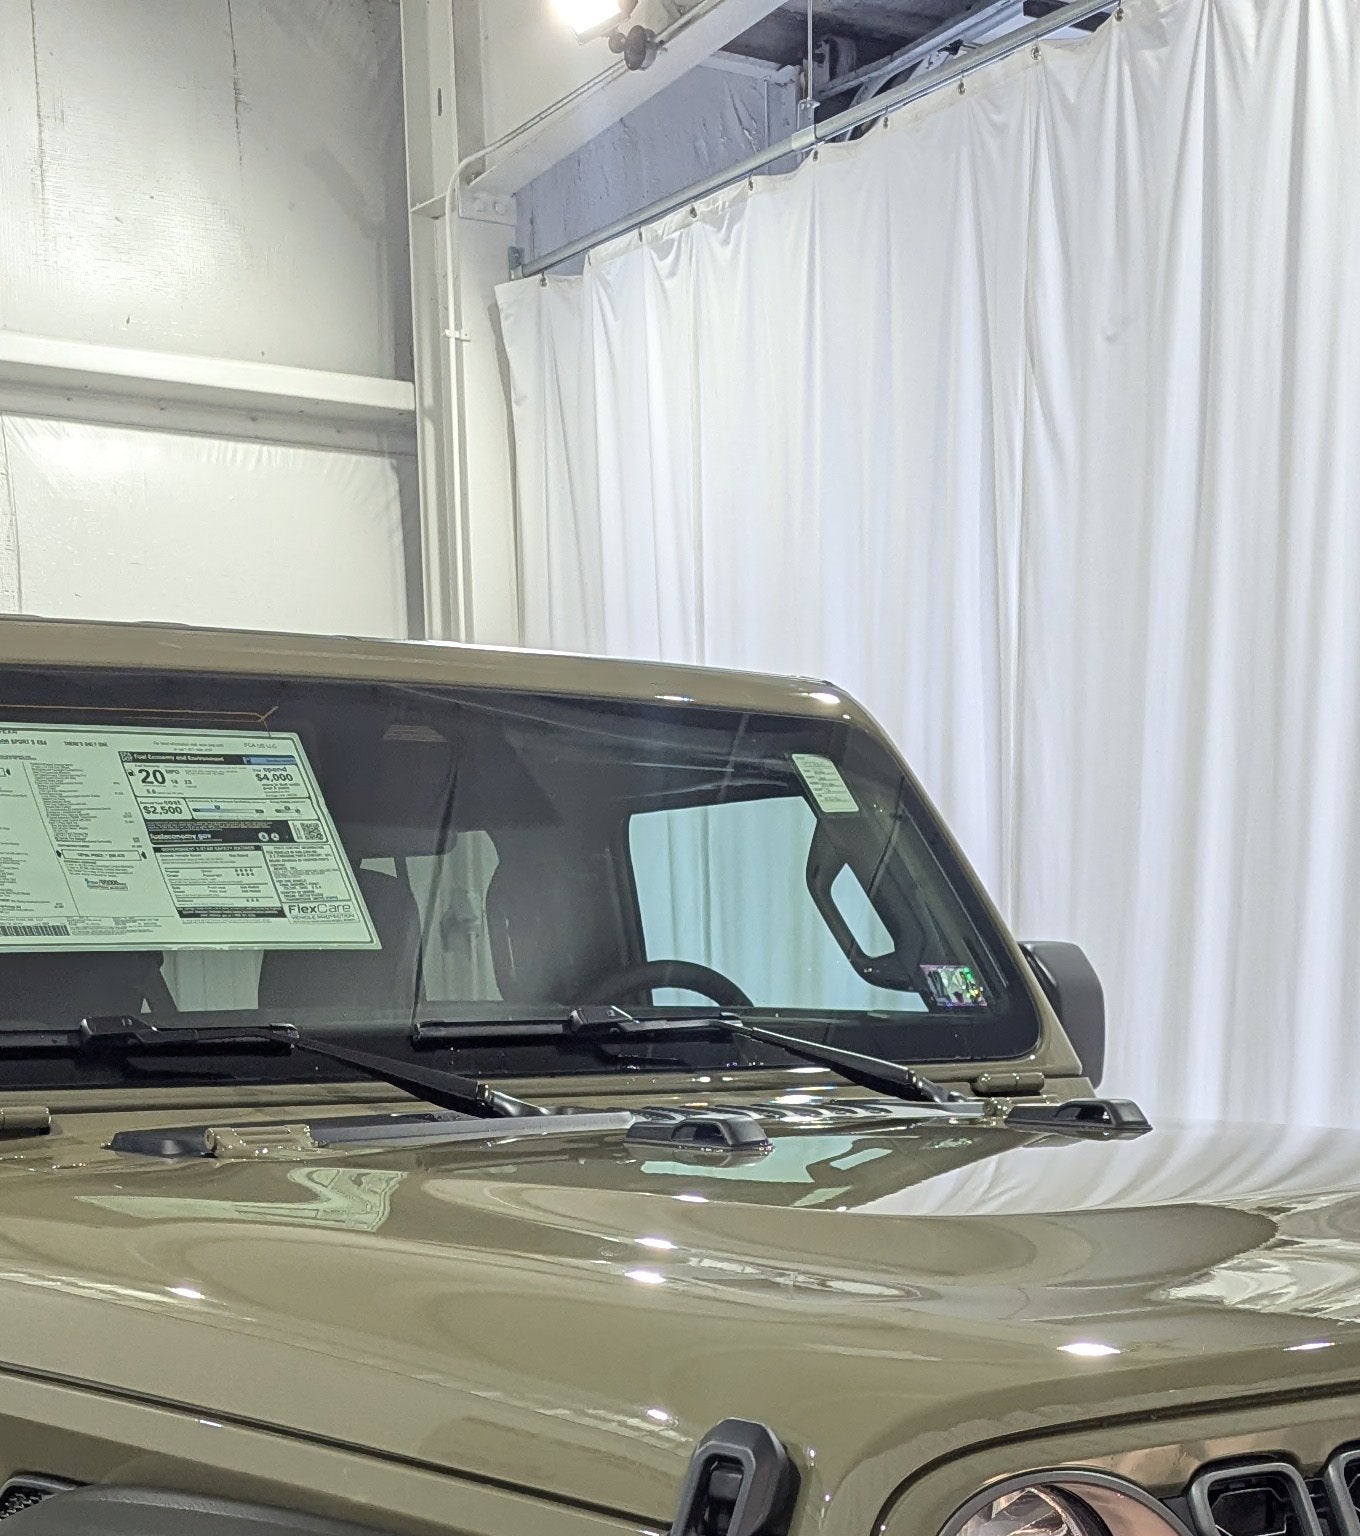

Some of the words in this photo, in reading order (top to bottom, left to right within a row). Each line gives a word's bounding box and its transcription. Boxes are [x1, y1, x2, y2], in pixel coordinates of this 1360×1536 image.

[138, 768, 166, 785] 20
[255, 773, 294, 782] $4,000
[143, 805, 183, 815] $2,500
[288, 903, 351, 914] FlexCare
